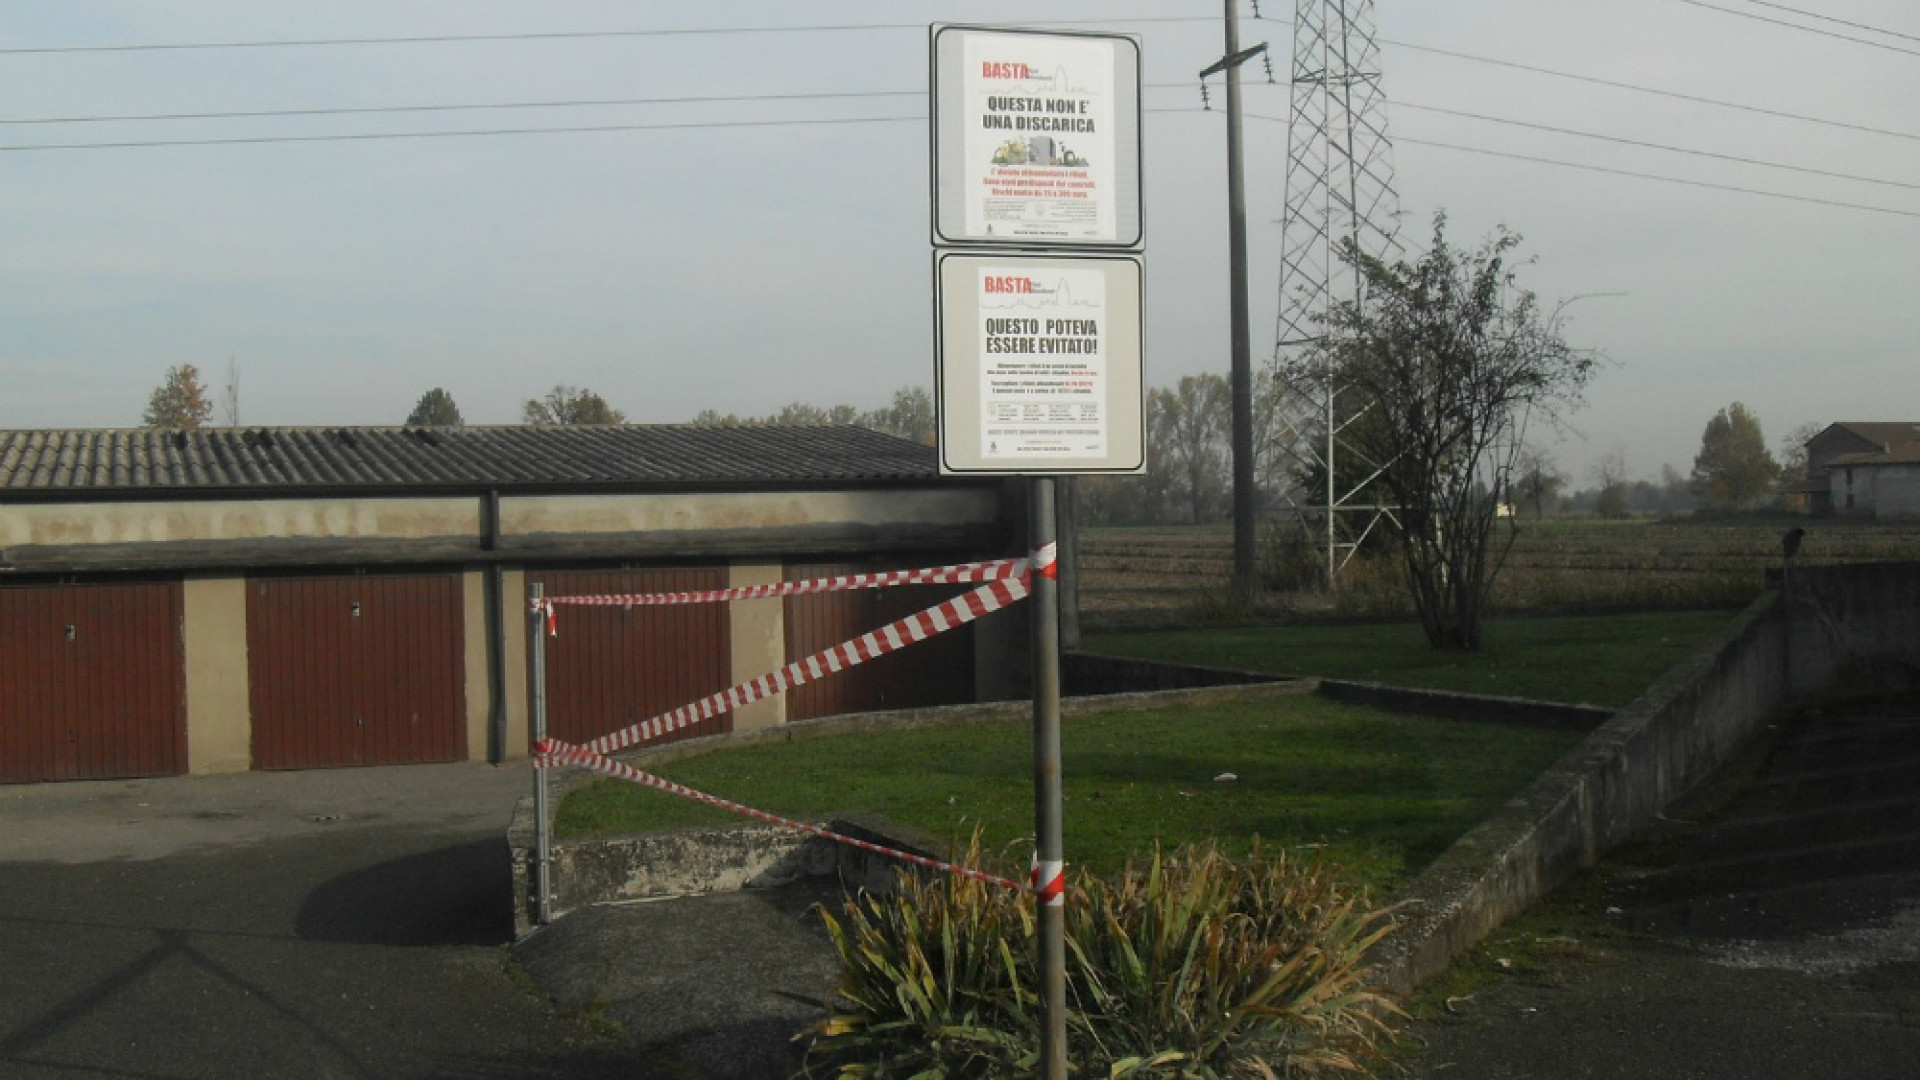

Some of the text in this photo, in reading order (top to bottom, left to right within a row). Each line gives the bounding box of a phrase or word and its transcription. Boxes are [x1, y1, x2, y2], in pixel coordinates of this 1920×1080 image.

[982, 61, 1029, 79] BASTA
[988, 95, 1043, 112] QUESTA
[1046, 98, 1076, 114] NON
[982, 114, 1095, 133] UNA DISCARICA
[984, 276, 1032, 293] BASTA
[986, 318, 1097, 336] QUESTO POTEVA
[986, 337, 1097, 354] ESSERE EVITATO!
